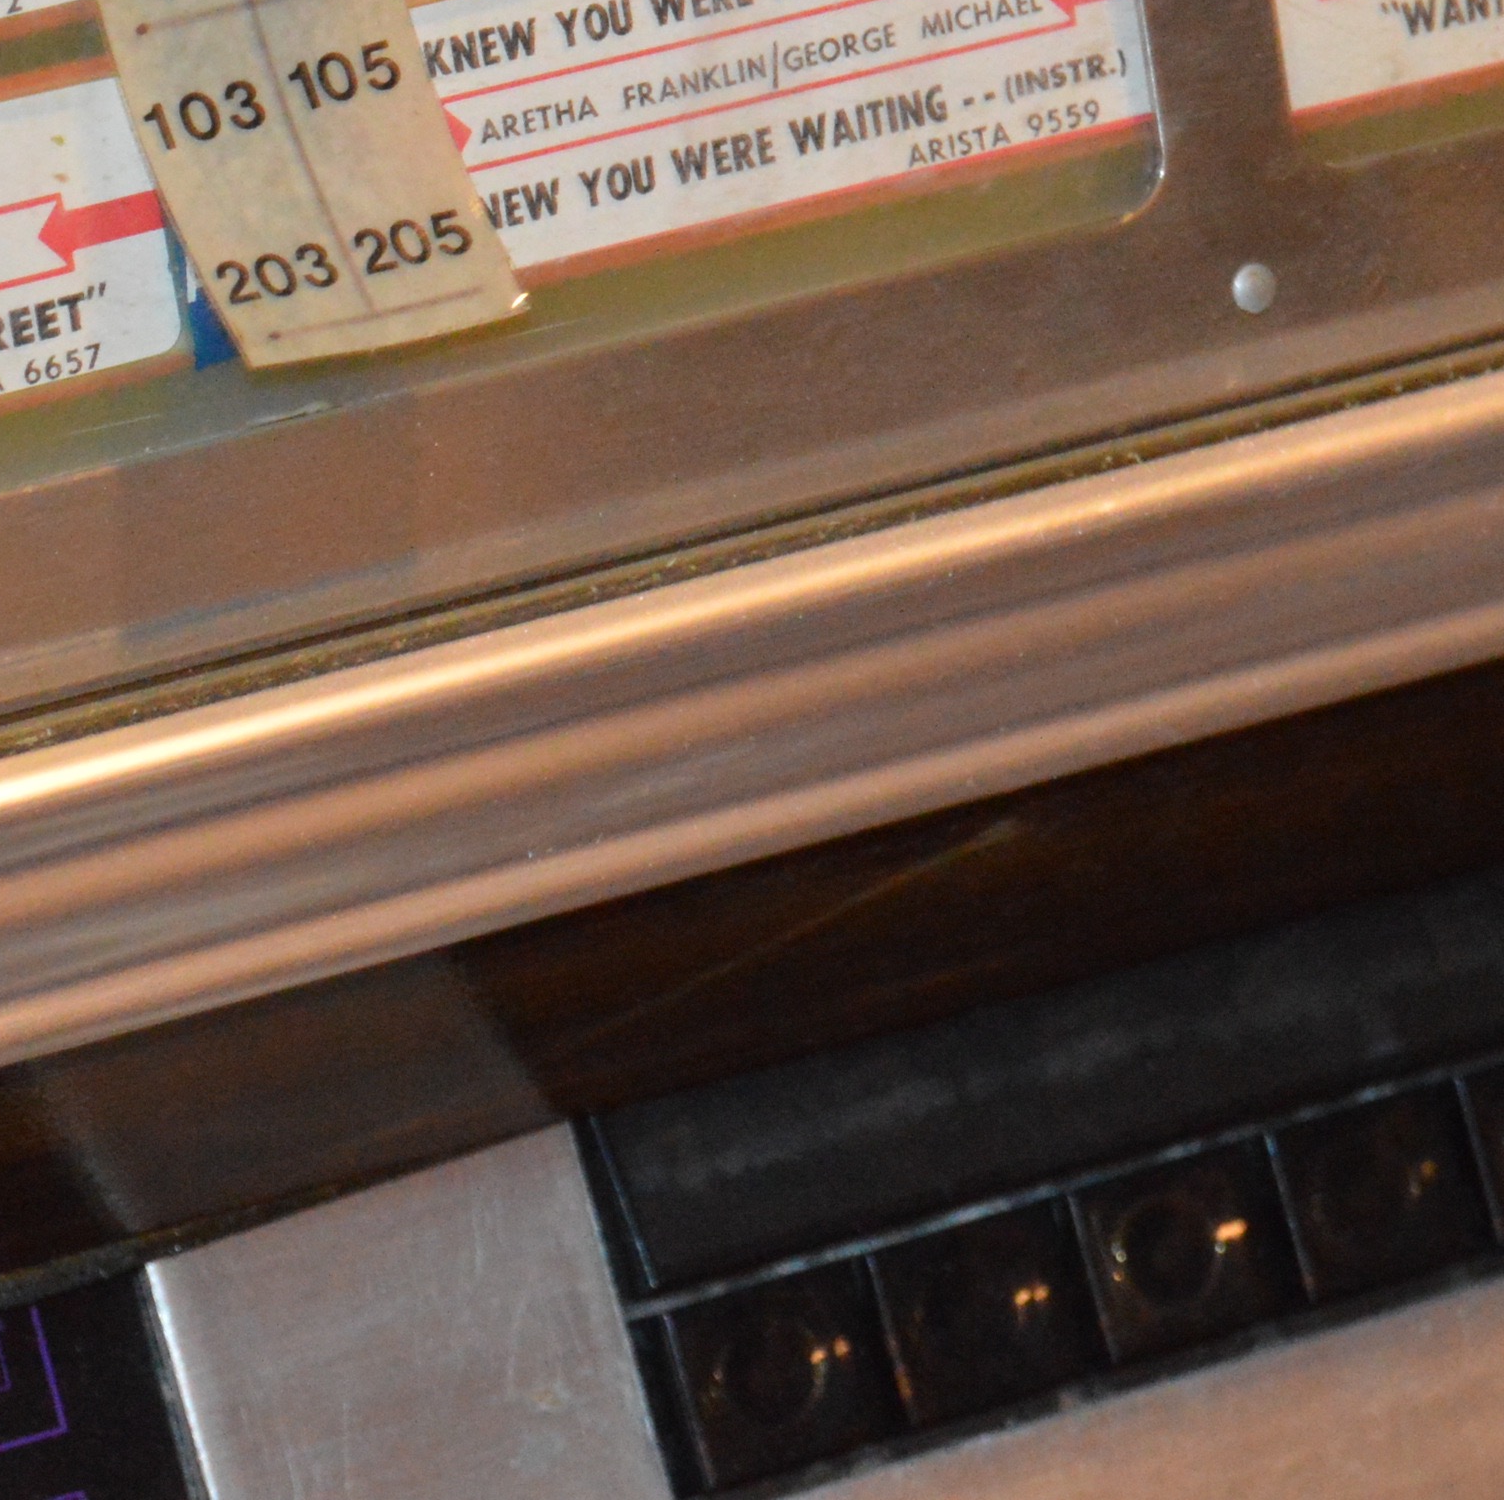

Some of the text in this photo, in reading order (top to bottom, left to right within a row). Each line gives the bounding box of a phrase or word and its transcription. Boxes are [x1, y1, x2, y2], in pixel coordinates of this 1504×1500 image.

[142, 40, 401, 151] 103 105
[422, 17, 536, 78] KNEW
[480, 95, 599, 147] ARETHA
[621, 22, 897, 111] FRANKLIN/GEORGE
[578, 155, 656, 210] YOU
[671, 134, 777, 185] WERE
[790, 90, 948, 157] WAITING
[1003, 48, 1126, 107] (INSTR.)
[908, 100, 1102, 169] ARISTA 9559
[217, 209, 473, 305] 203 205
[24, 343, 103, 388] 6657
